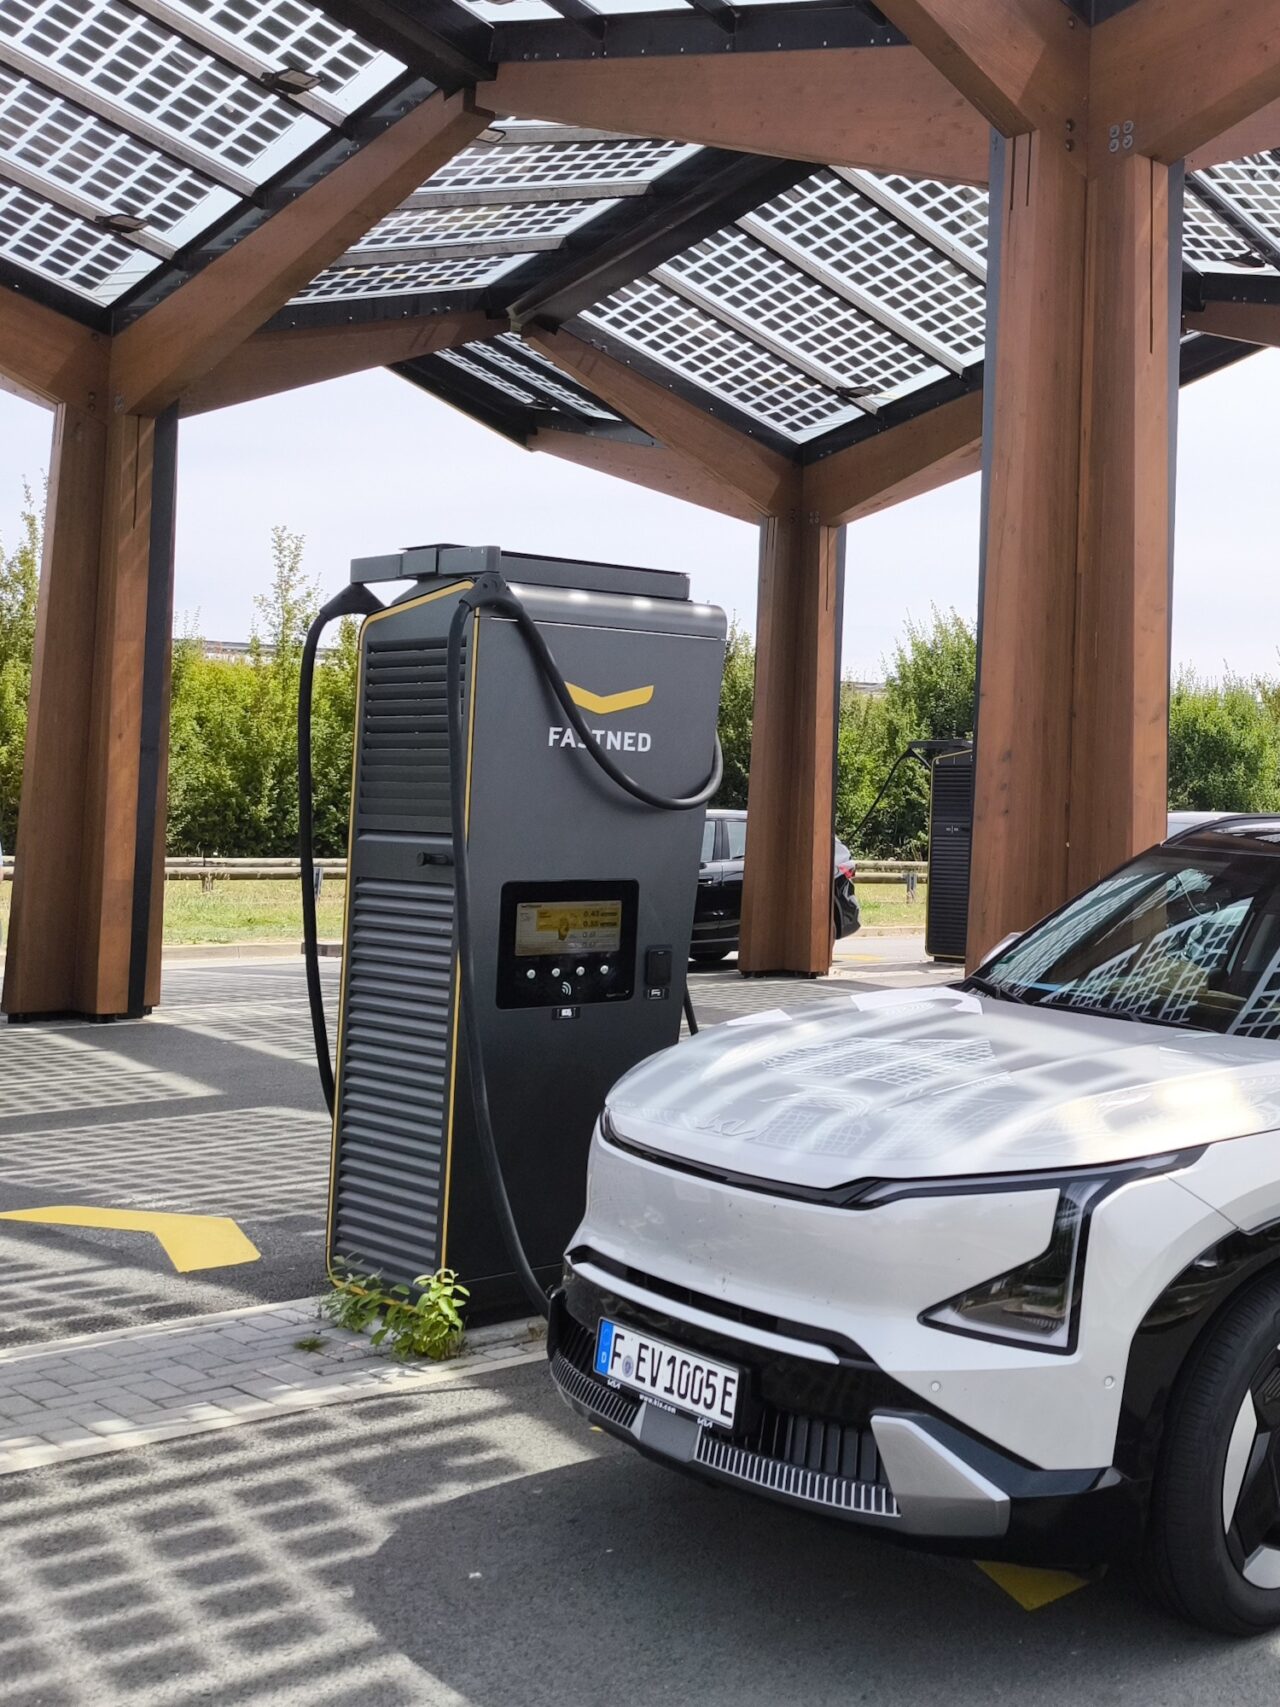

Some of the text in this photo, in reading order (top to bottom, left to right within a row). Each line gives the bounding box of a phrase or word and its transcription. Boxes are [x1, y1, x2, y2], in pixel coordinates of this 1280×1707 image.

[548, 726, 652, 753] FATNED
[600, 1351, 607, 1364] D
[639, 1393, 677, 1415] www.kia.com
